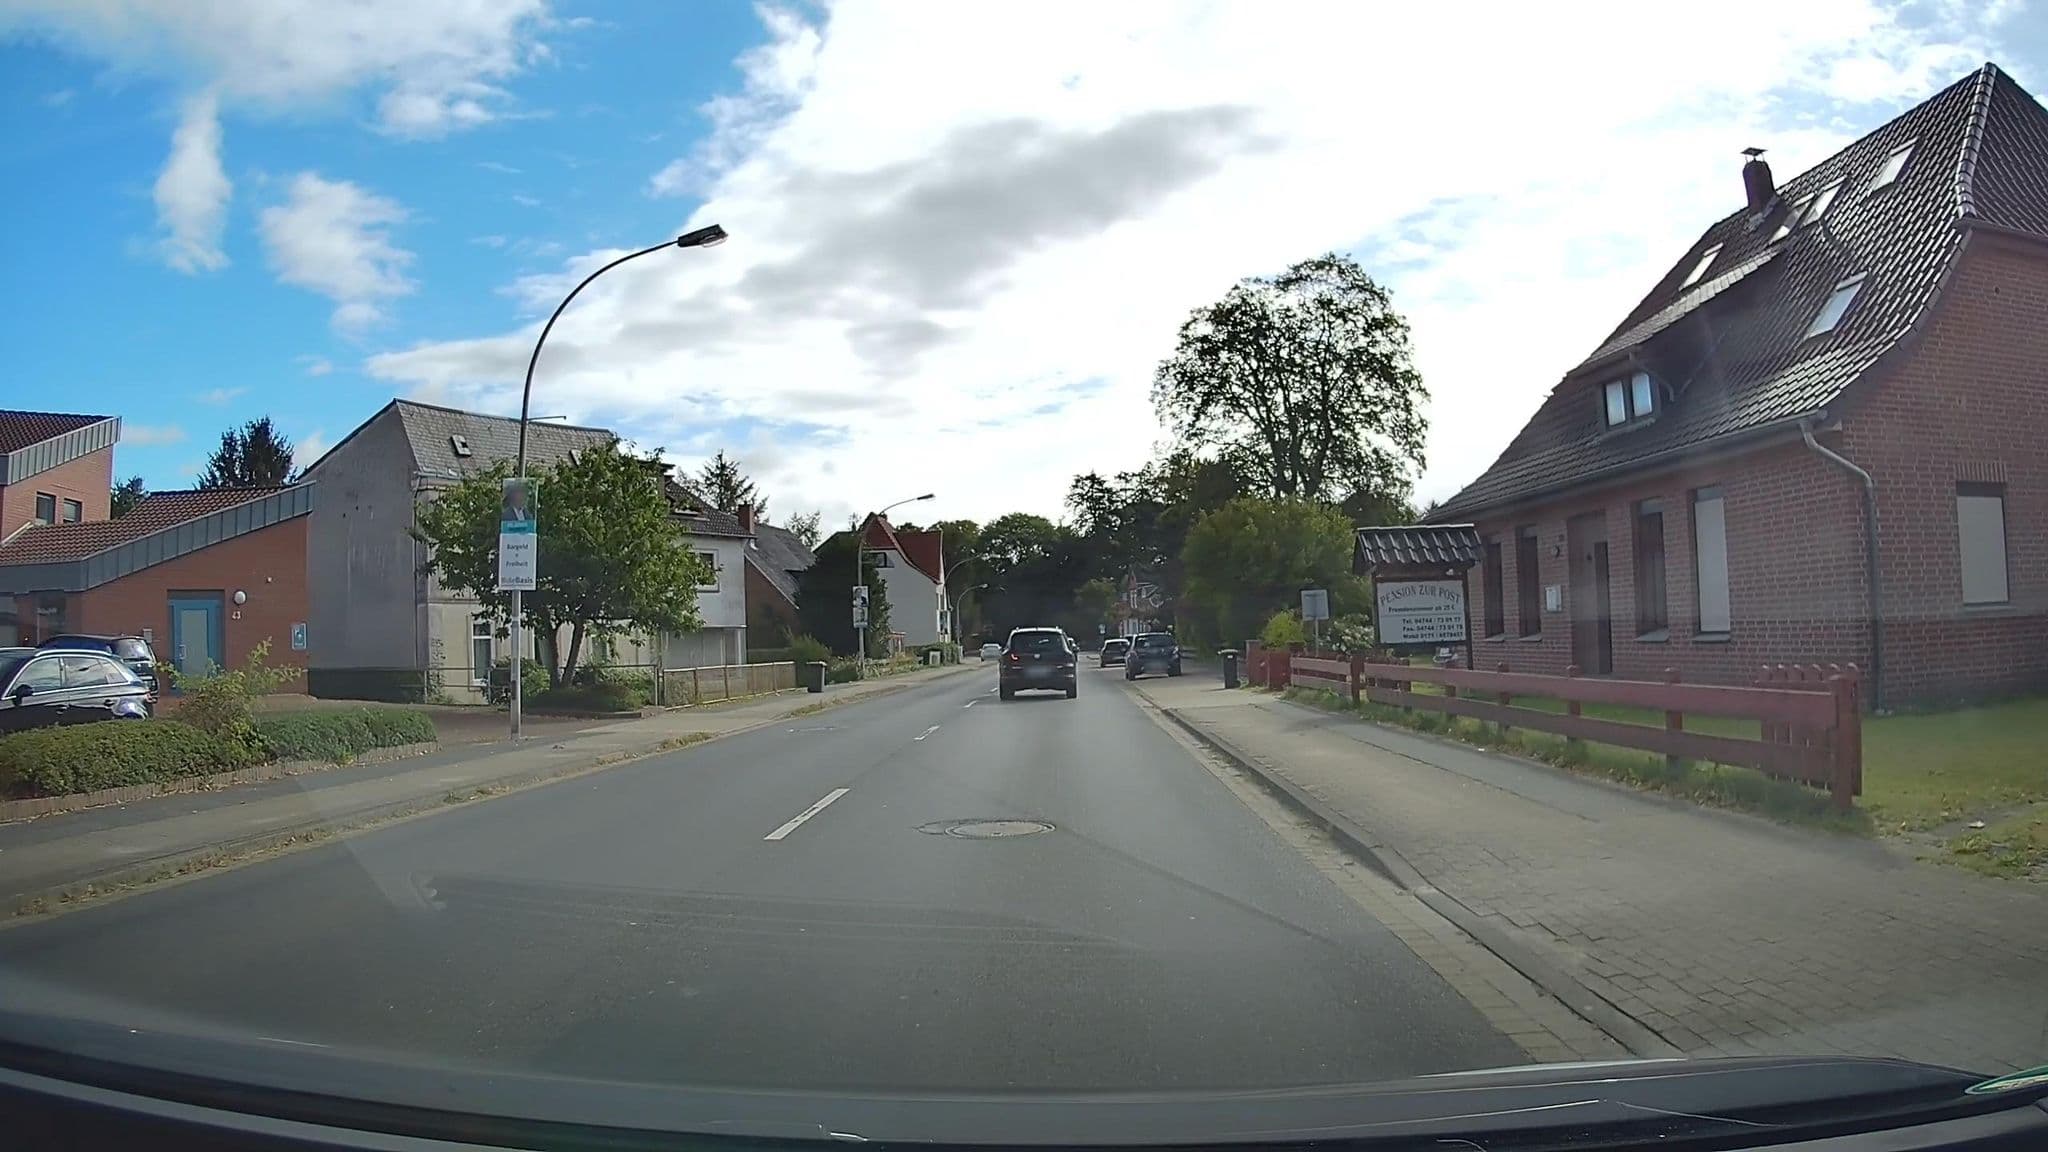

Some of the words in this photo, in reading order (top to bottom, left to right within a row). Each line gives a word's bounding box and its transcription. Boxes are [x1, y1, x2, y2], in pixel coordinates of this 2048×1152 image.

[1380, 585, 1416, 606] PENSION
[1418, 584, 1436, 598] ZUR
[1438, 586, 1461, 604] POST
